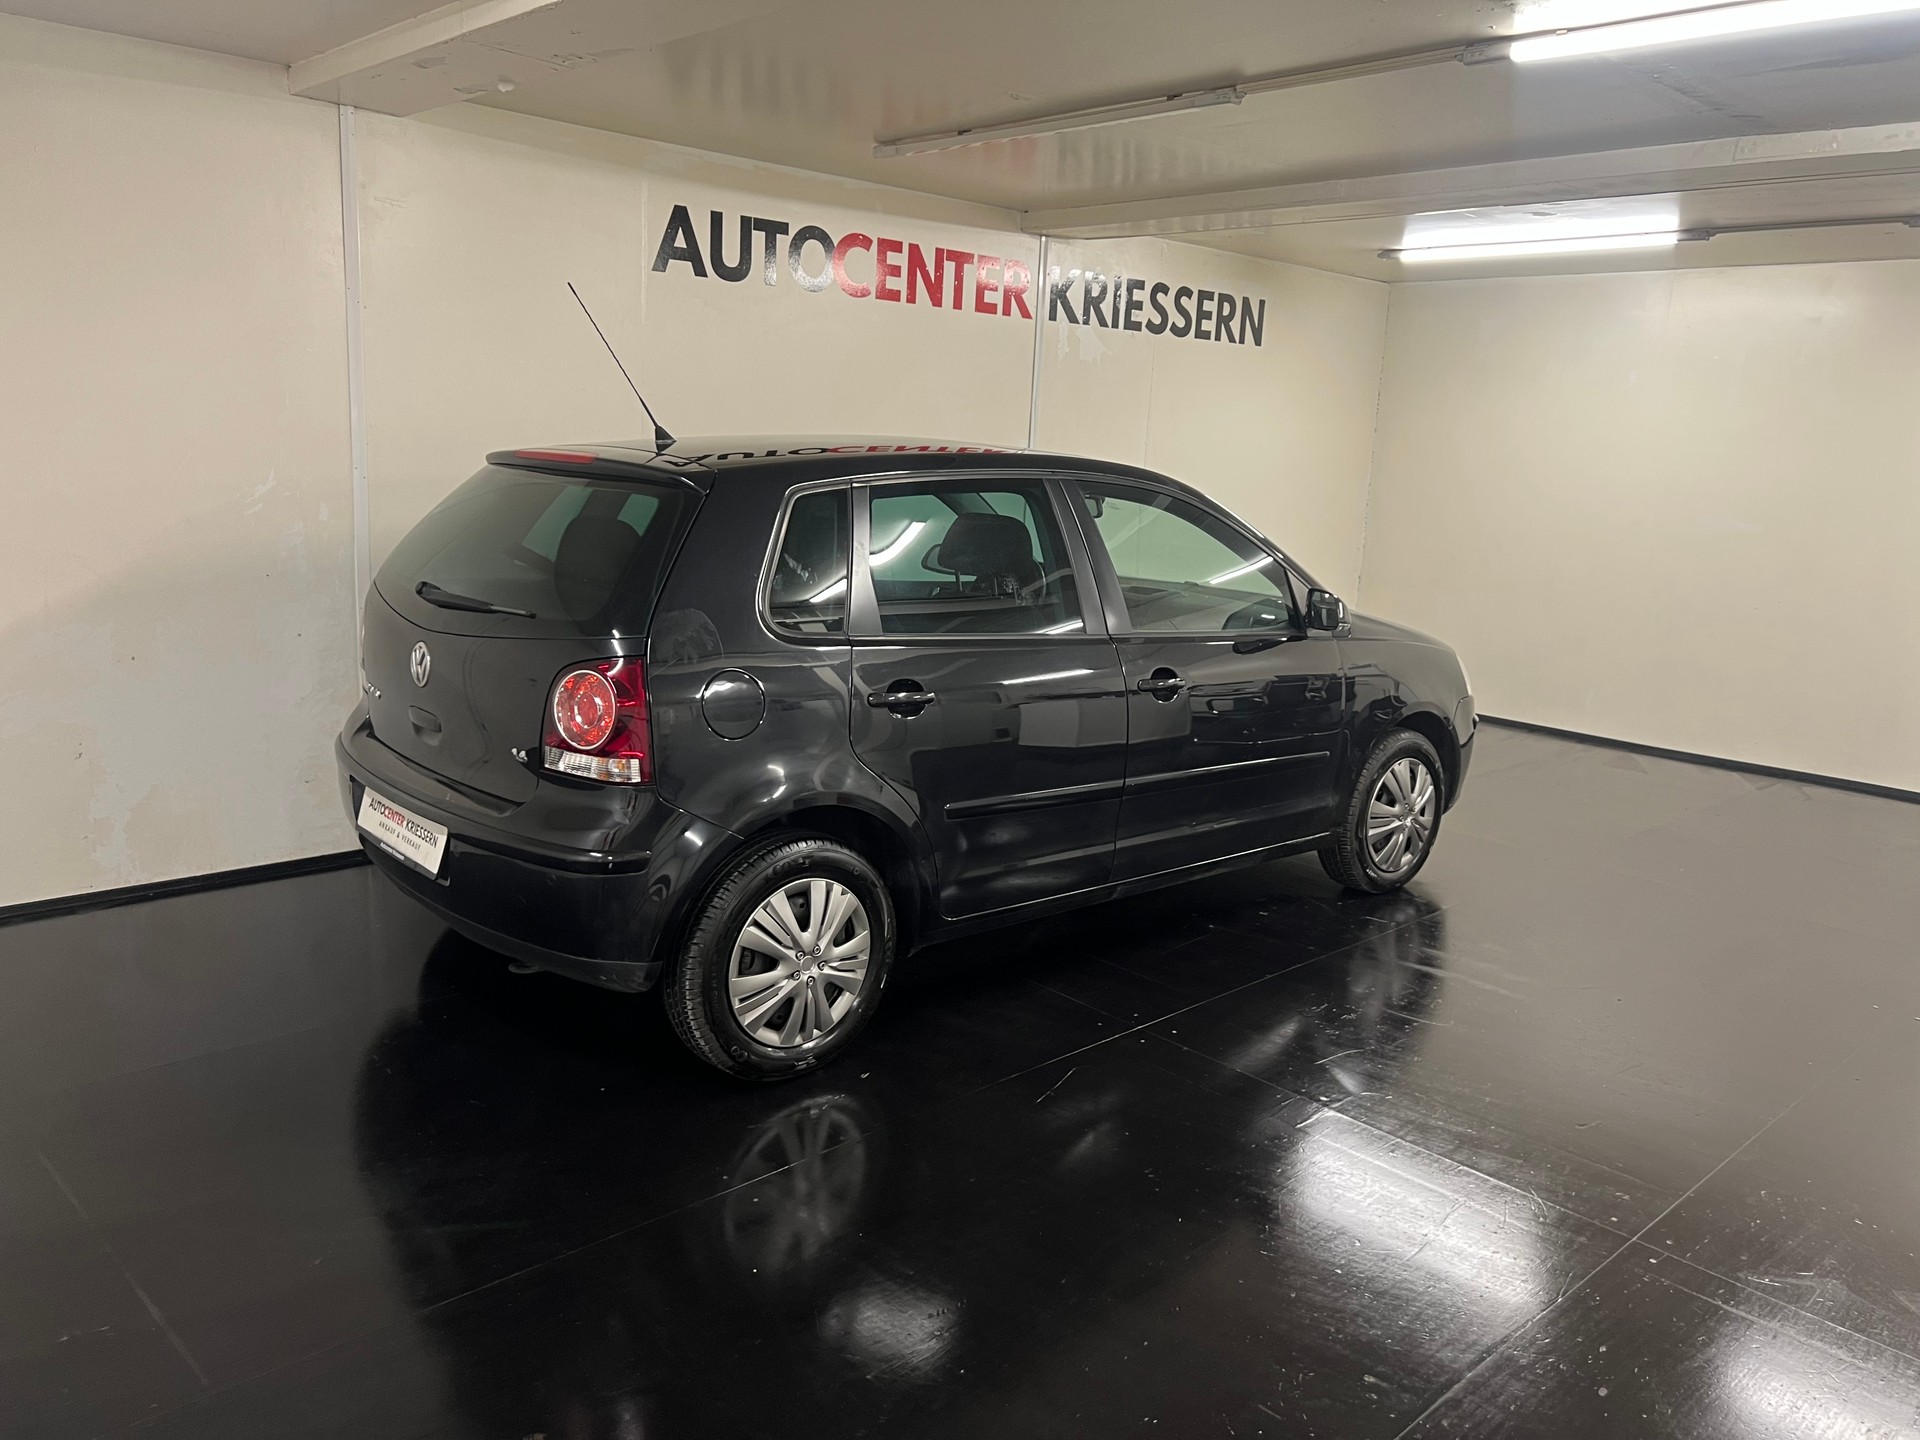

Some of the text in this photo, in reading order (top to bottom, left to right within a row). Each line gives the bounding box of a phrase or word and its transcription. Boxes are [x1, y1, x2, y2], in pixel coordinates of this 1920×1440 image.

[652, 204, 1267, 347] AUTOCENTER KRIESSERN
[368, 797, 439, 849] AUTOCENTER KRIESSERN
[378, 820, 396, 834] ANKAUF
